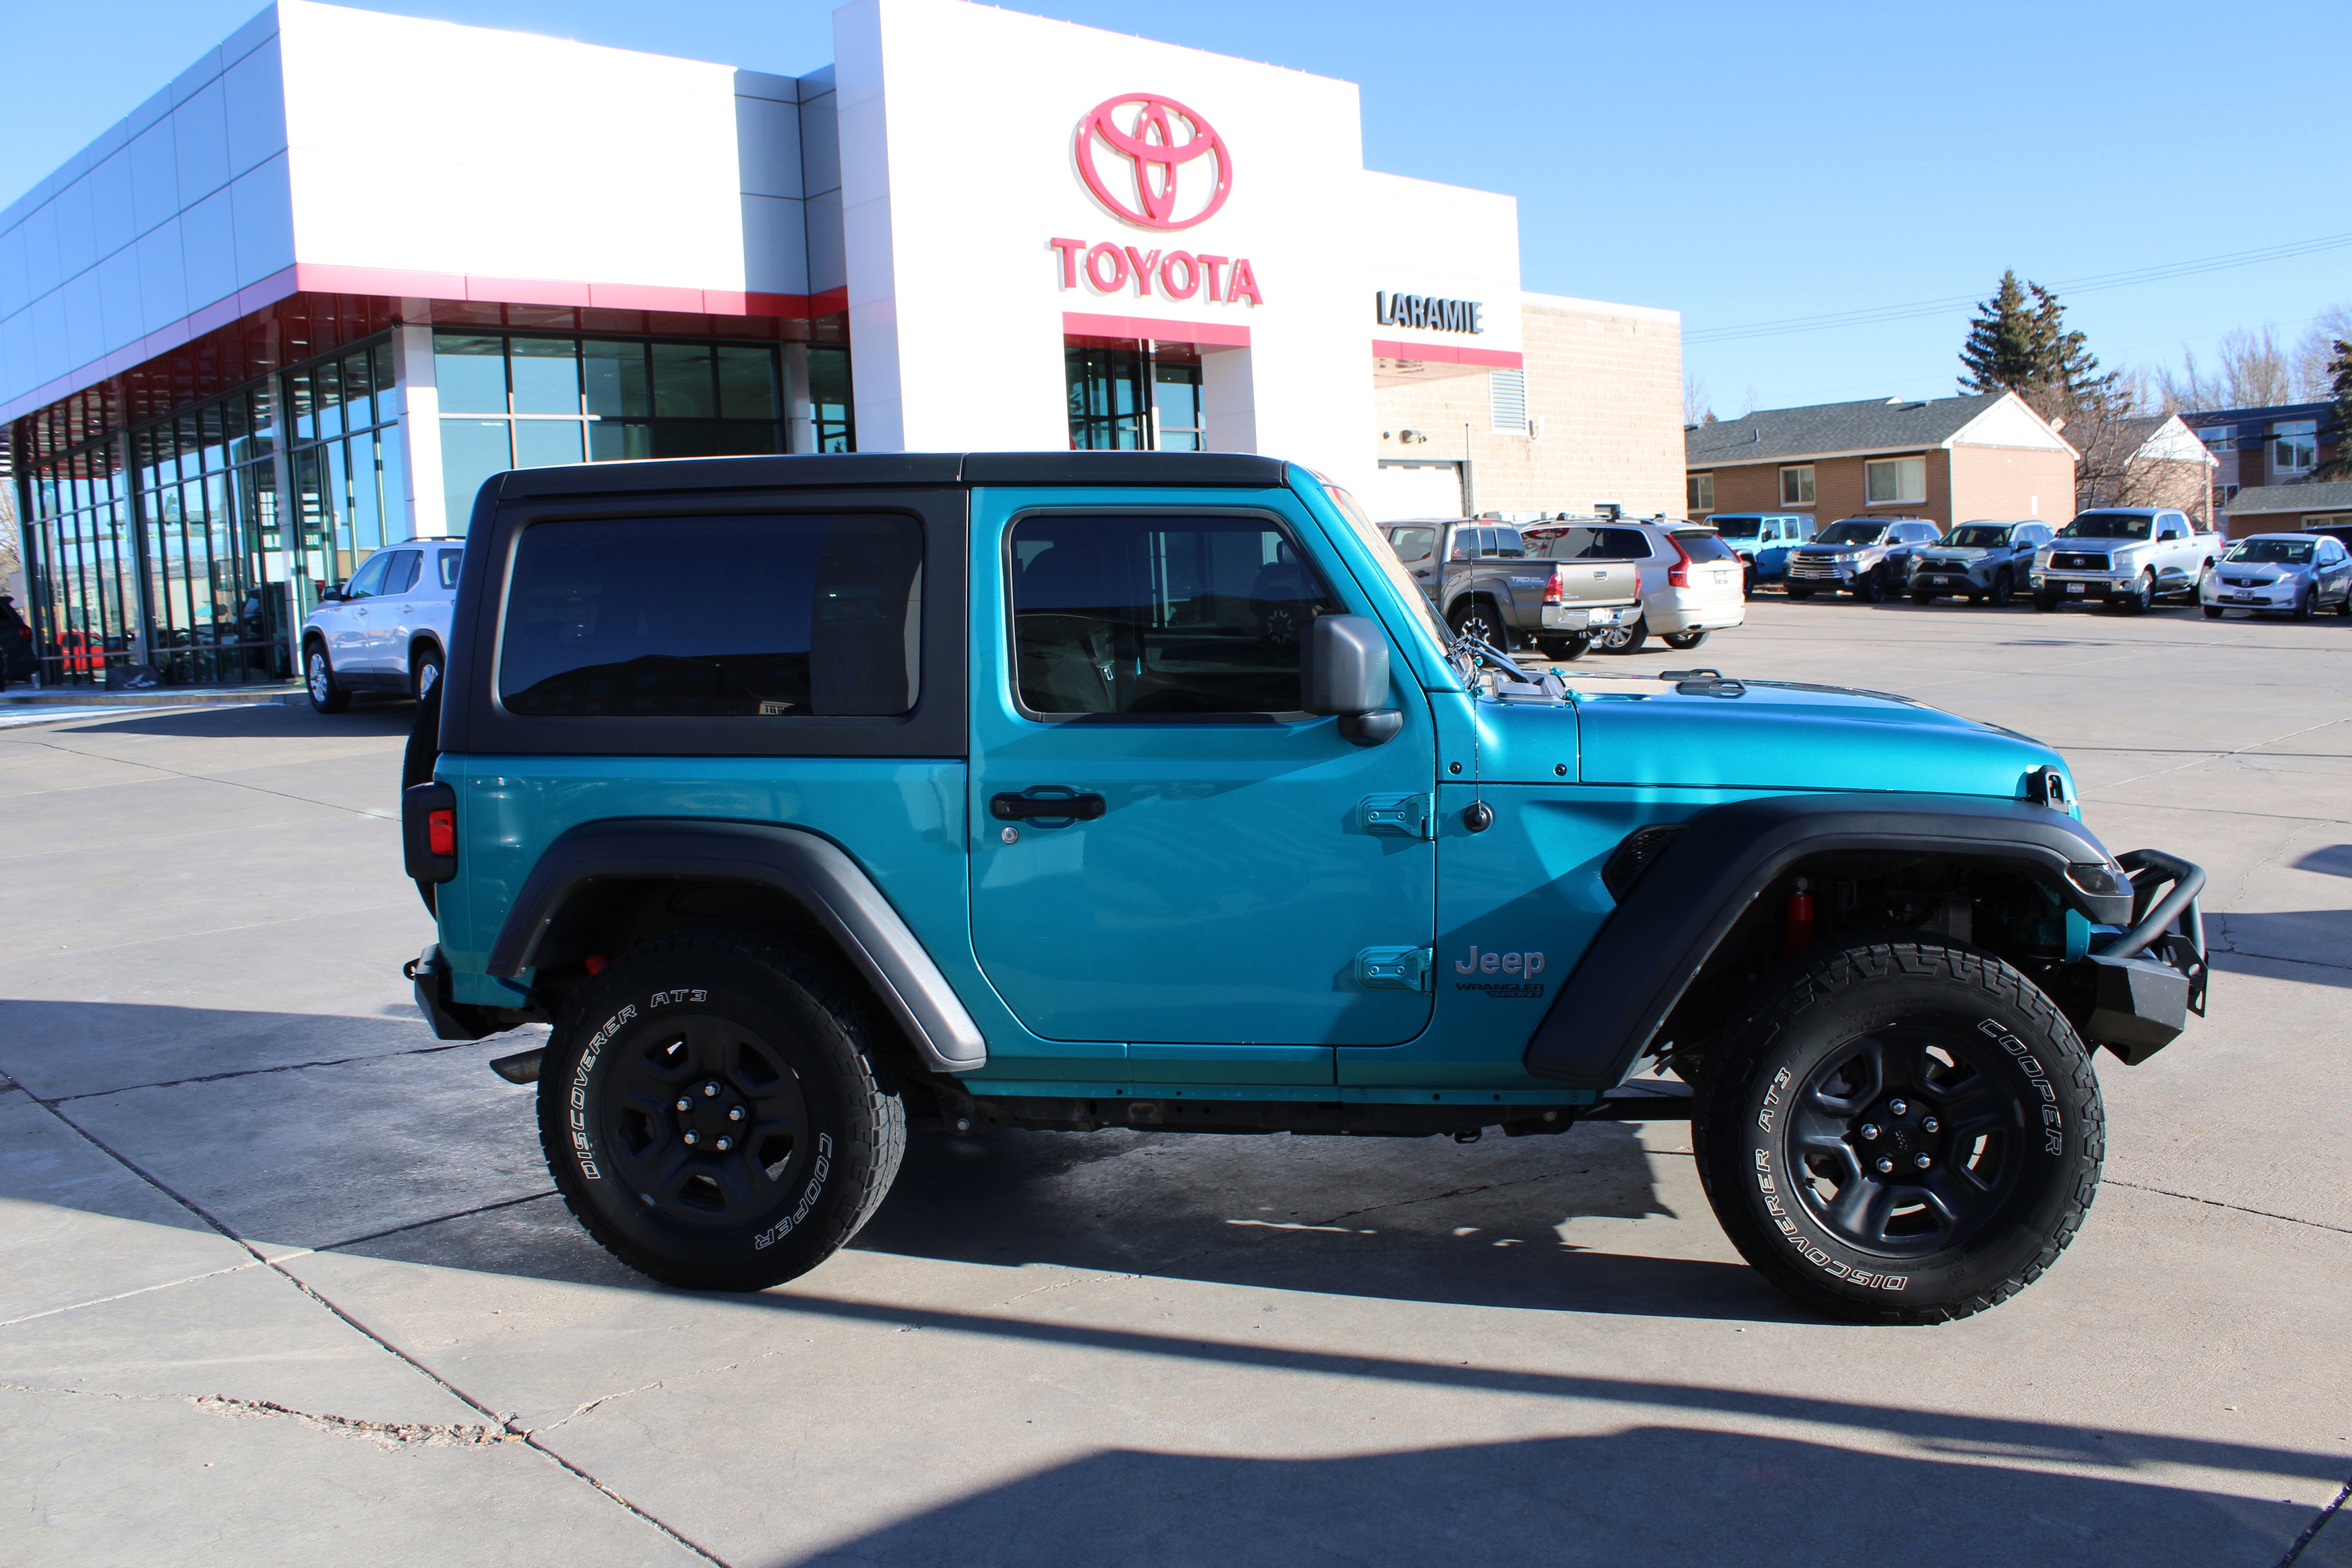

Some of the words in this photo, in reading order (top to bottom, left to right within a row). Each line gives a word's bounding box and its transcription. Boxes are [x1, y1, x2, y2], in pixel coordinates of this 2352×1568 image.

[1049, 237, 1264, 305] TOYOTA
[1376, 291, 1483, 334] LARAMIE
[1455, 945, 1545, 979] Jeep
[1455, 982, 1545, 991] WRANGLER
[570, 1004, 637, 1180] DISCOVERER
[650, 989, 707, 1007] AT3
[1758, 1067, 1791, 1133] AT3
[1977, 1018, 2062, 1156] COOPER
[755, 1132, 832, 1250] COOPER
[1753, 1148, 1907, 1291] DISCOVERER
